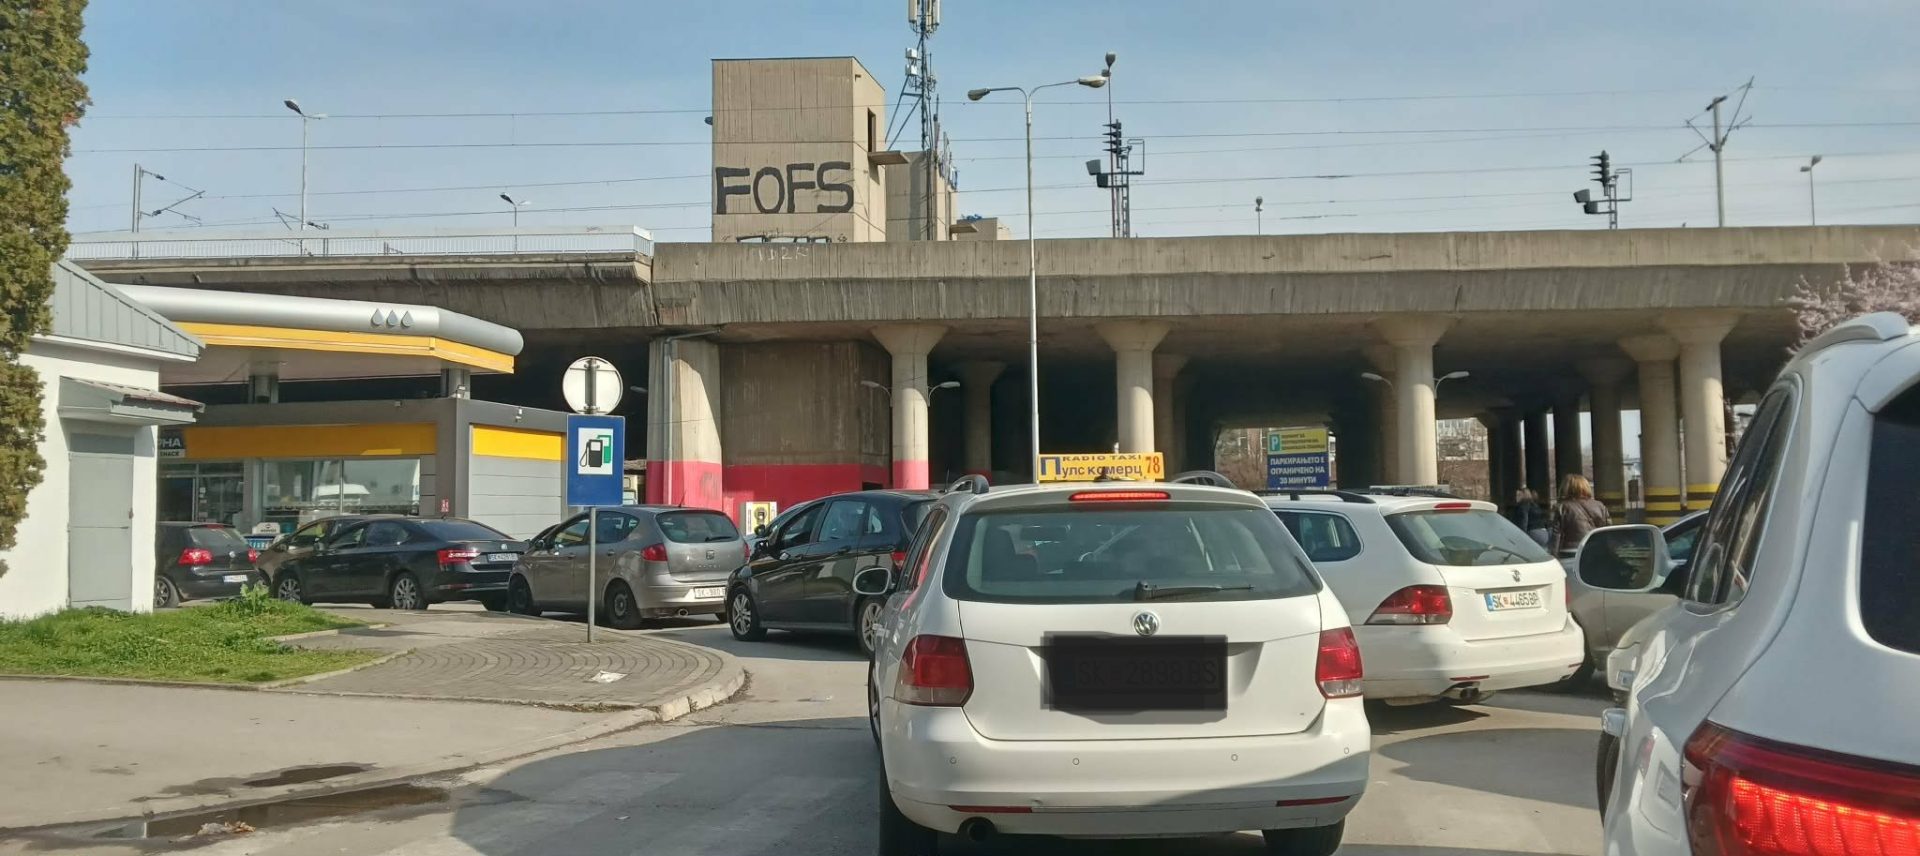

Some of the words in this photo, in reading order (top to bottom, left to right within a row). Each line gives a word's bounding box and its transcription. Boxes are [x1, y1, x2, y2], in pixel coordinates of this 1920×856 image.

[716, 161, 854, 214] FOFS
[1040, 456, 1085, 478] Пулс
[1145, 456, 1161, 474] 78
[1270, 467, 1315, 475] ОГРАНИЧЕНО
